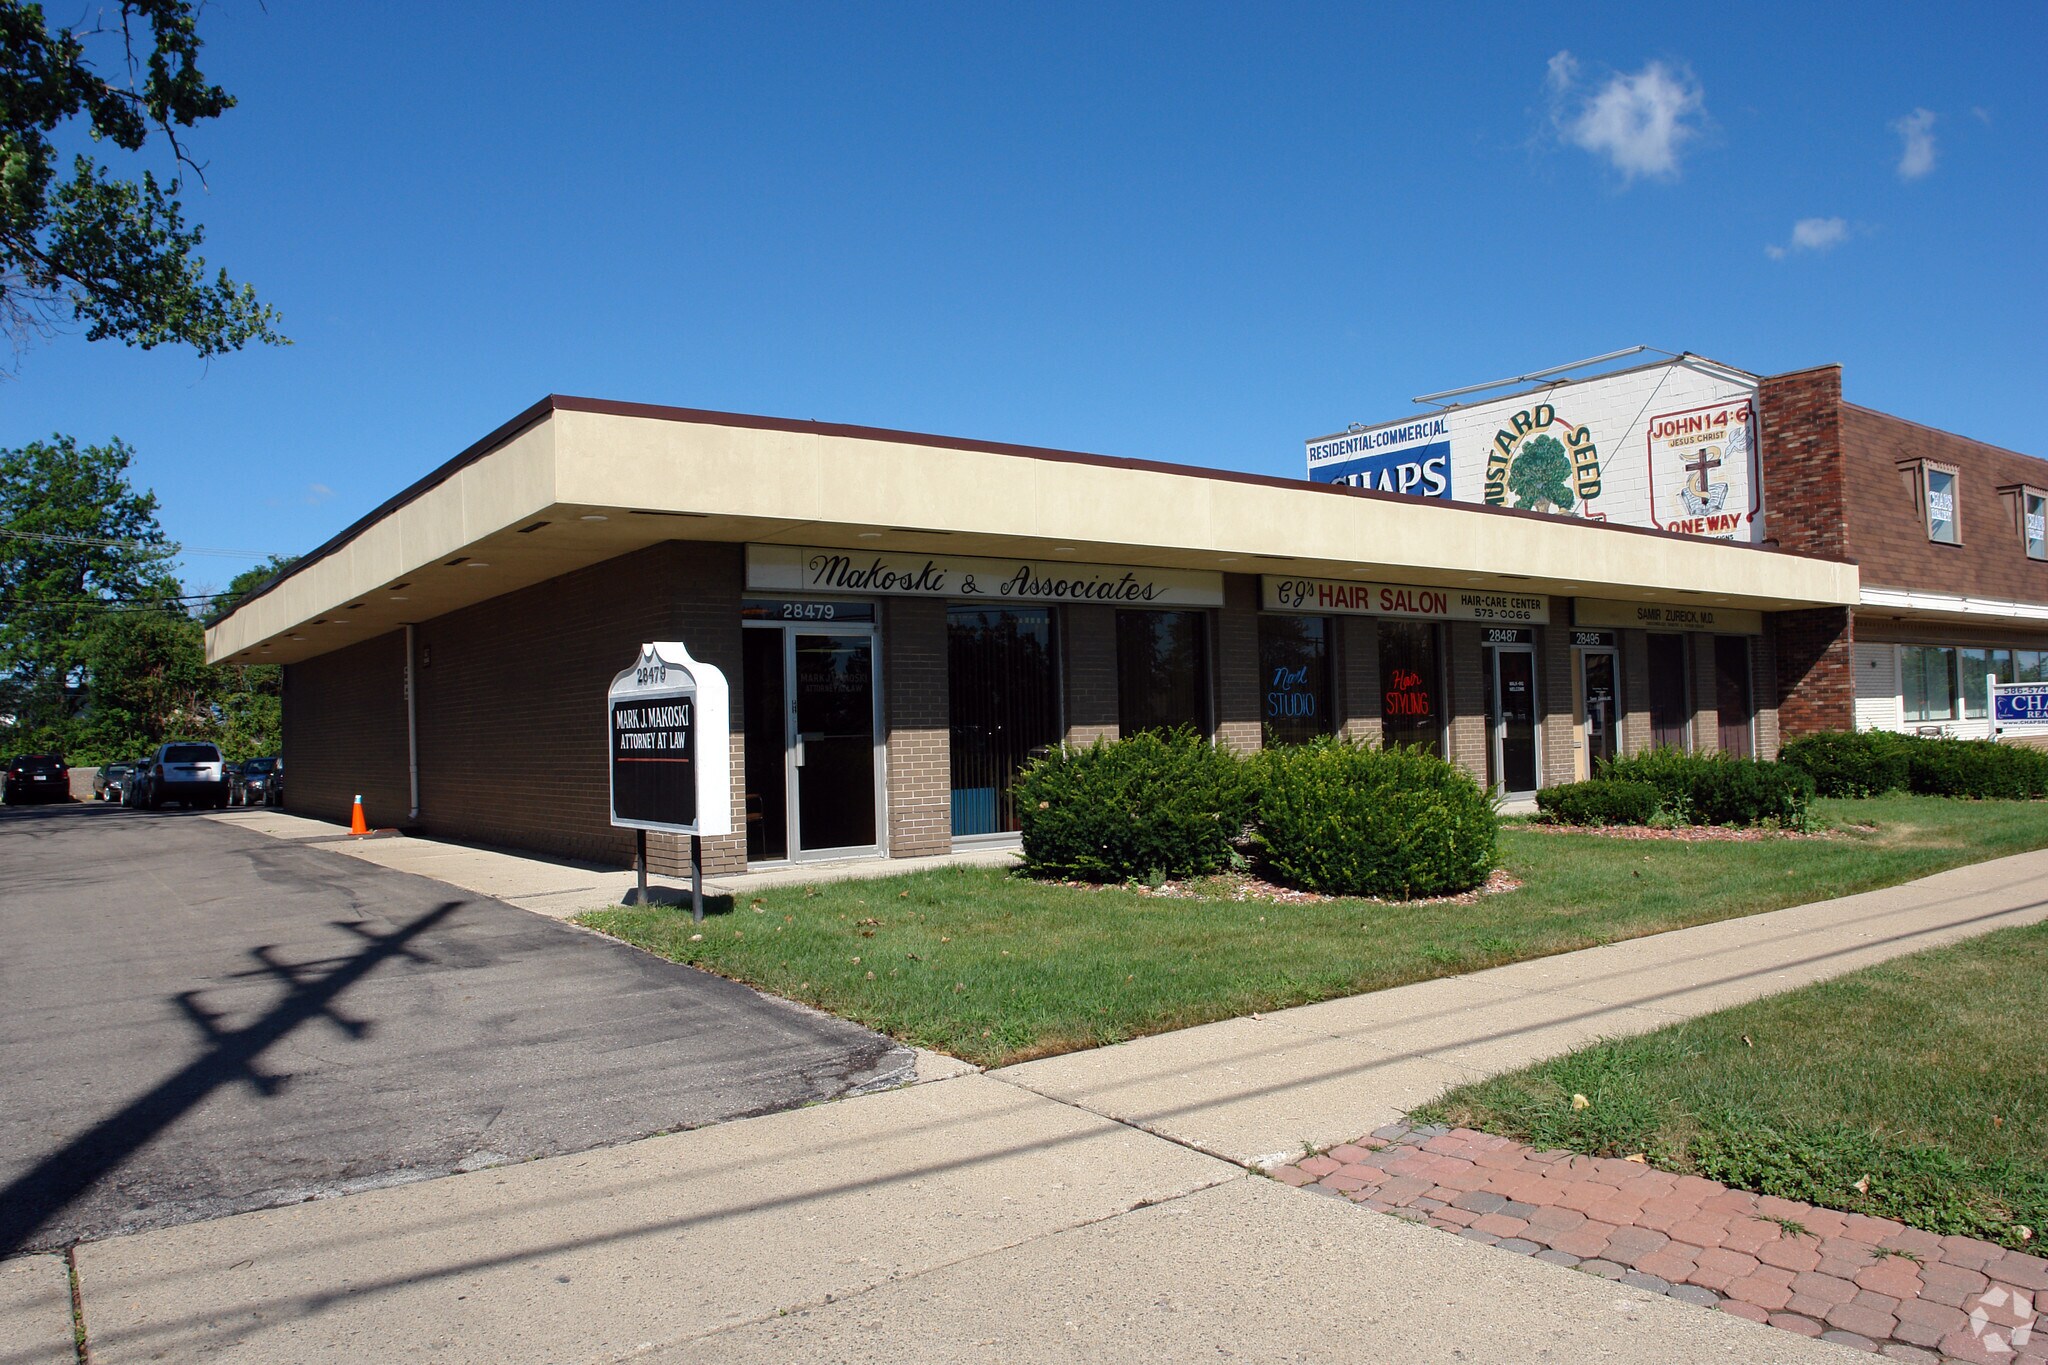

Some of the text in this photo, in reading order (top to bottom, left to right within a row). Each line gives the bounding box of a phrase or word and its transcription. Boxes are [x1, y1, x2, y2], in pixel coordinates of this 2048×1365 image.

[1653, 405, 1749, 439] JOHN 14:6
[1309, 419, 1449, 461] RESIDENTIAL-COMMERCIAL
[1670, 431, 1725, 448] JESUS CHRIST
[1567, 426, 1602, 499] SEED
[1330, 455, 1447, 497] APS
[1668, 513, 1742, 533] ONE WAY
[809, 555, 1171, 600] Makoski & Associates
[1318, 584, 1369, 609] HAIR
[1380, 588, 1447, 614] SALON
[1461, 595, 1541, 610] HAIR-CARE CENTER
[783, 603, 835, 620] 28479
[1474, 608, 1531, 620] 573-0066
[1637, 607, 1662, 620] SAMIR
[1700, 611, 1715, 624] M.D.
[1488, 629, 1518, 642] 28487
[1576, 632, 1600, 645] 28495
[636, 665, 667, 685] 28479
[1392, 669, 1422, 691] Hair
[1268, 692, 1315, 717] STUDIO
[1386, 692, 1429, 715] STYLING
[616, 704, 689, 729] MARK J. MAKOSKI
[620, 731, 686, 749] ATTORNEY AT LAW
